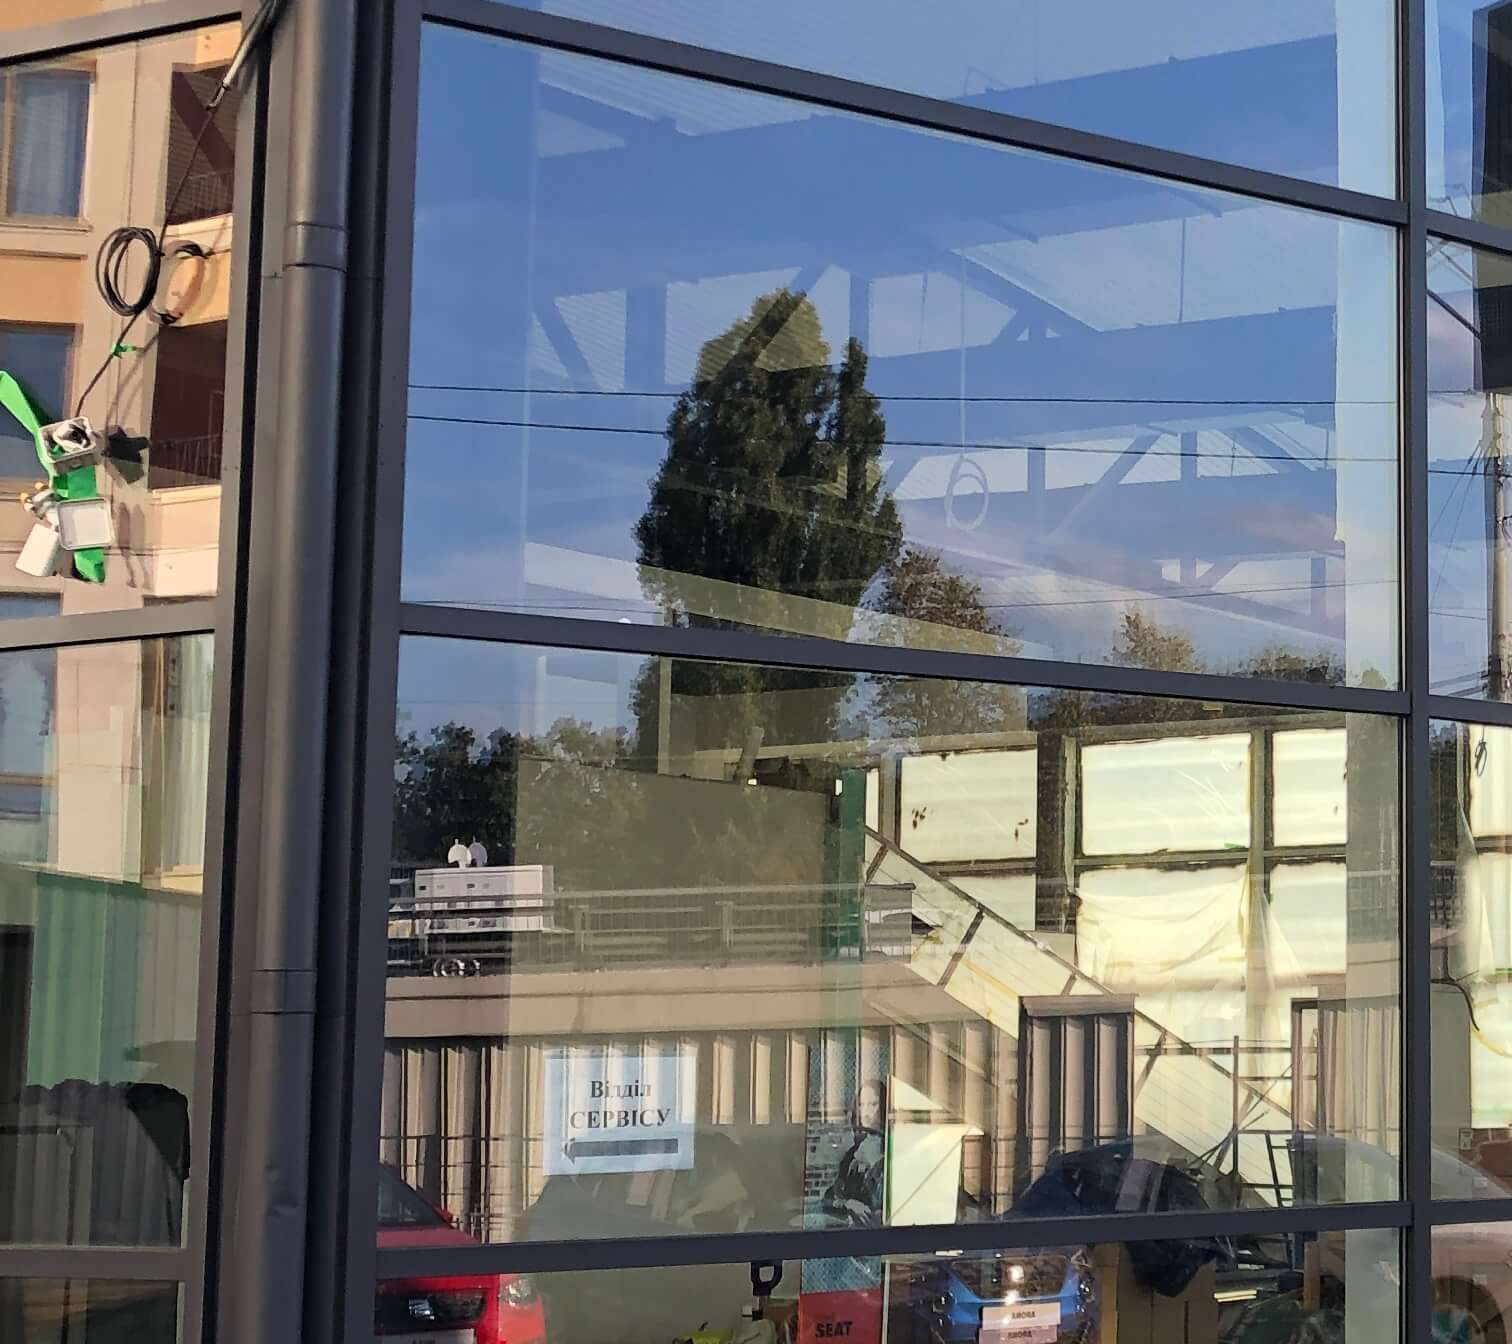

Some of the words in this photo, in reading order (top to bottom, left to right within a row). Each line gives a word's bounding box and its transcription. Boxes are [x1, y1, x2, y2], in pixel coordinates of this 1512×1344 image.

[591, 1080, 651, 1098] Відділ
[570, 1108, 671, 1129] СЕРВІСУ
[815, 1321, 853, 1337] SEAT
